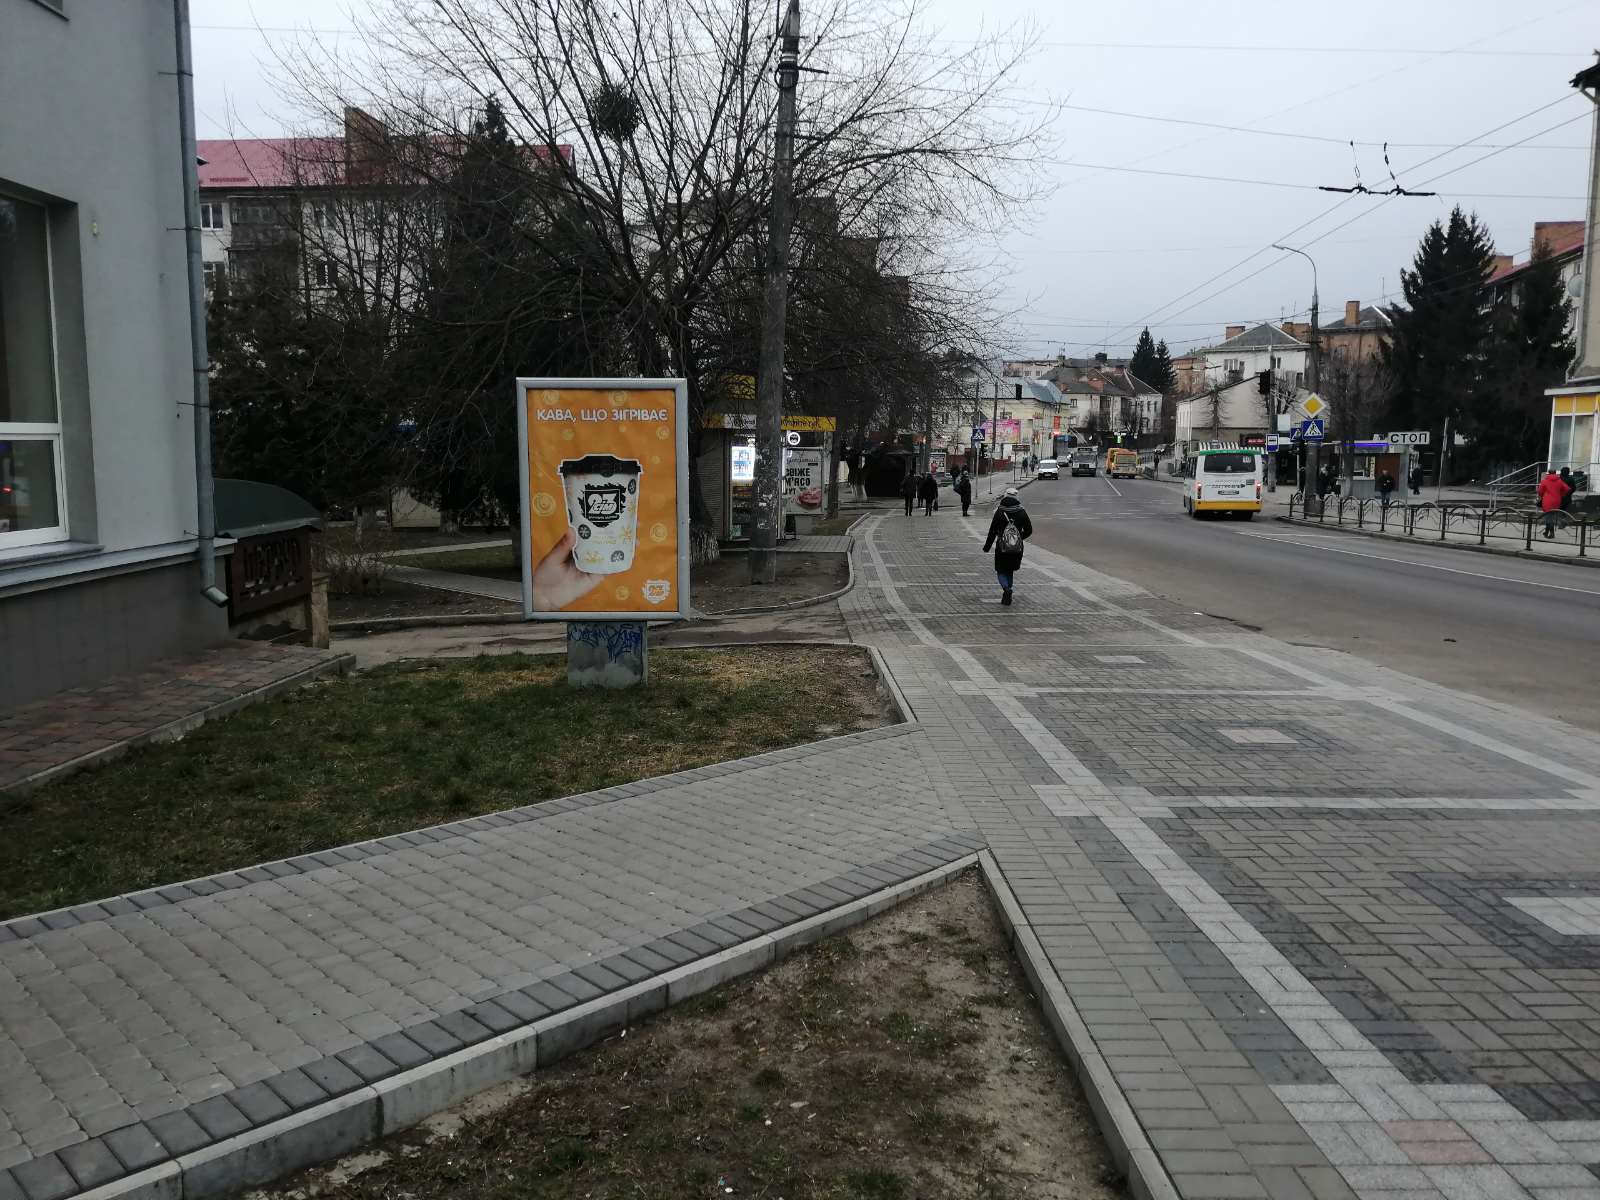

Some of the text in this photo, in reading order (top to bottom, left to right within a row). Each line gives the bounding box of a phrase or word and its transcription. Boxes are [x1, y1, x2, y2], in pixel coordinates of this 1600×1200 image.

[537, 408, 668, 422] КАВА, ЩО ЗІГРІВАЄ
[1390, 433, 1428, 443] СТОП
